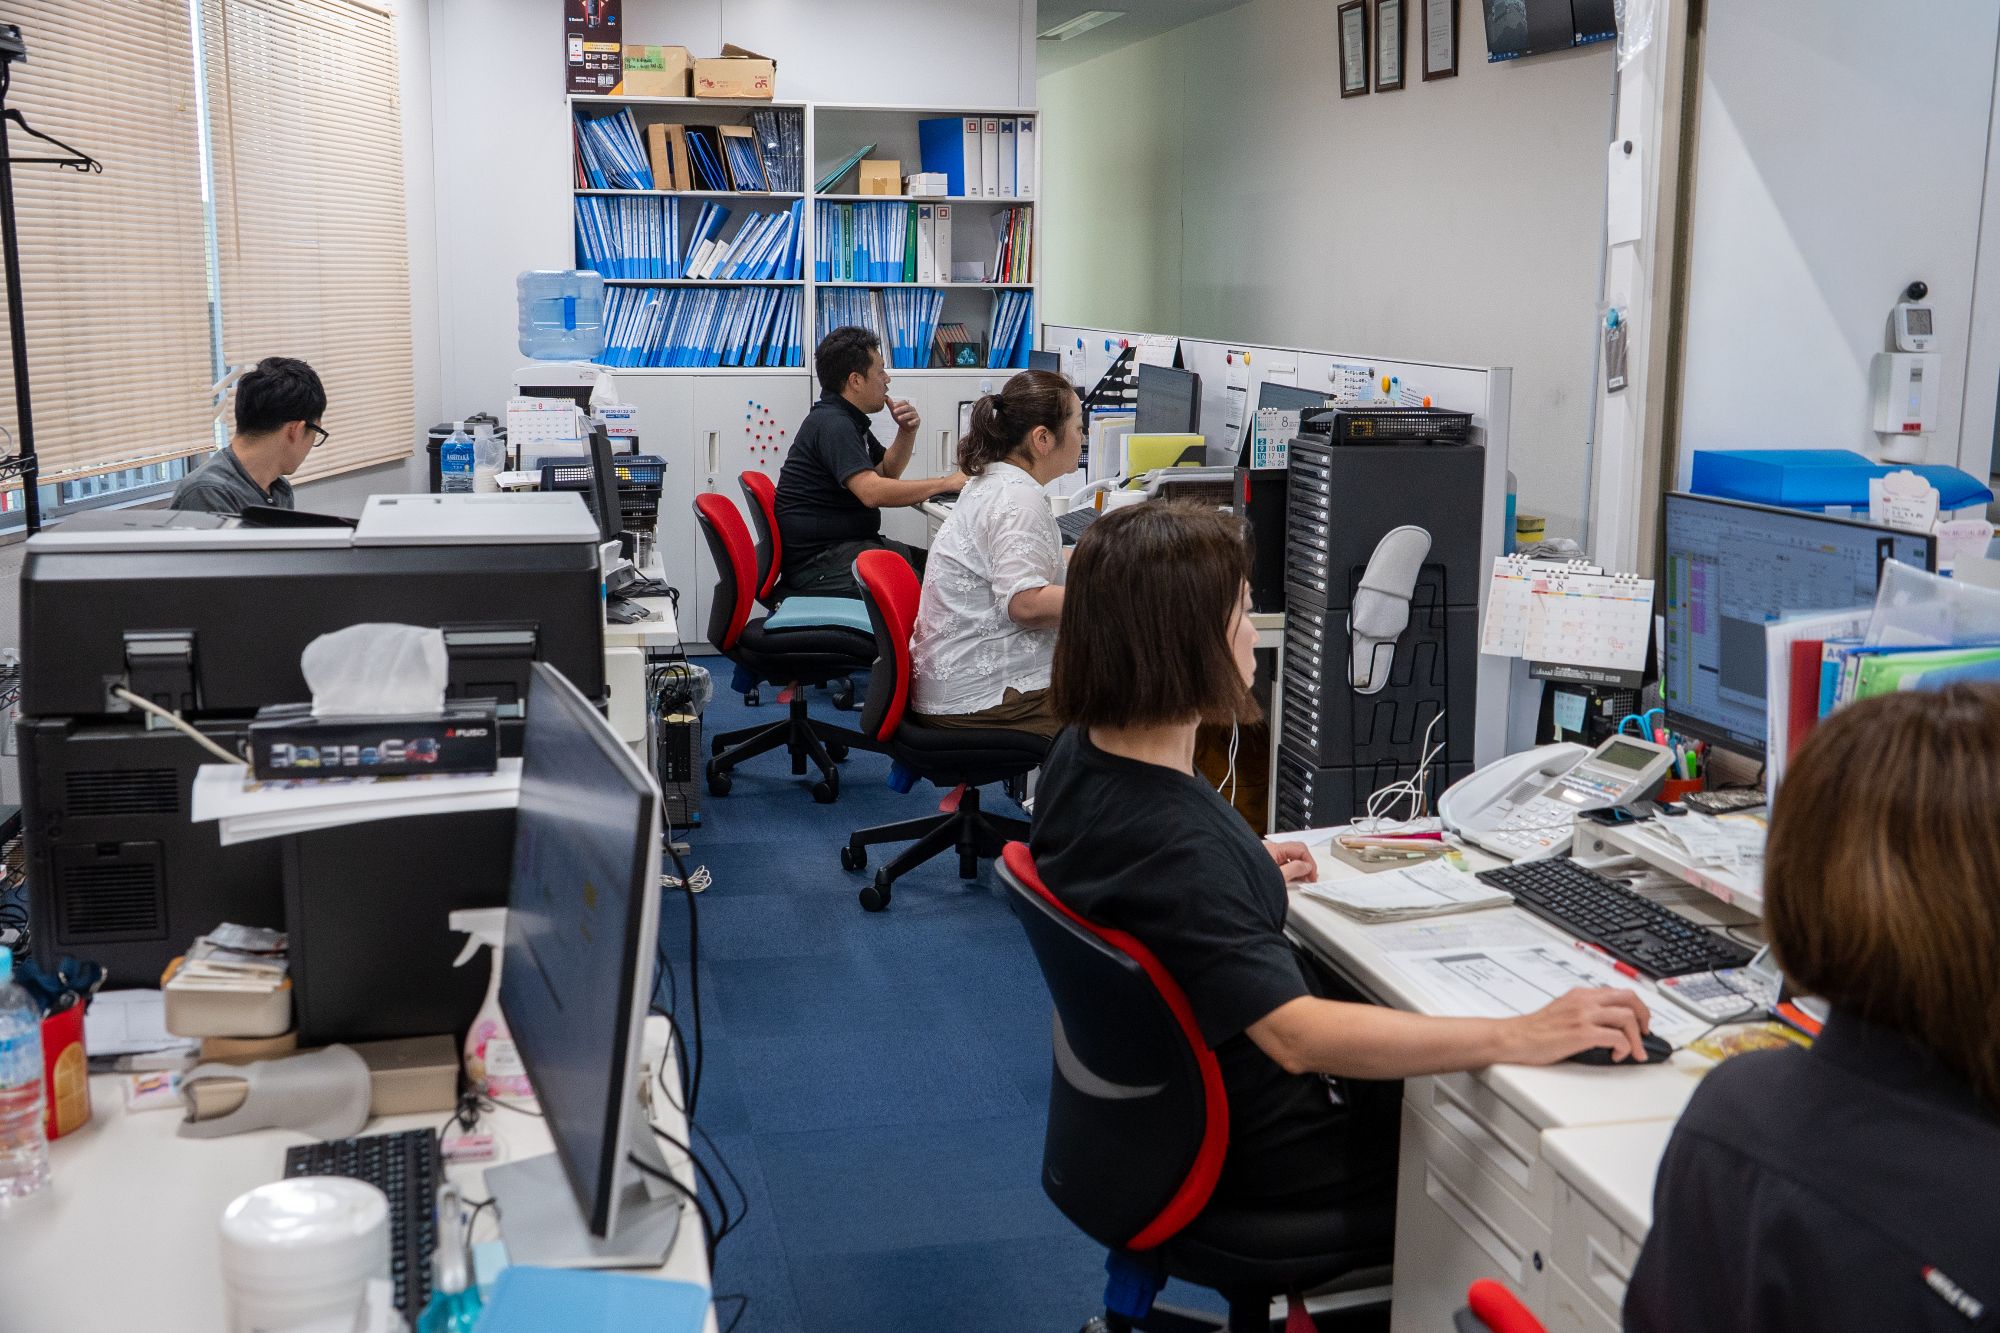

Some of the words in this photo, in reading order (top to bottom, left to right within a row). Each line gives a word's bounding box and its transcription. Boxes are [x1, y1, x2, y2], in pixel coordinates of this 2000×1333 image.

[1281, 416, 1289, 428] 8
[1516, 566, 1523, 577] 8
[1556, 580, 1564, 592] 8
[455, 729, 488, 737] FUSO
